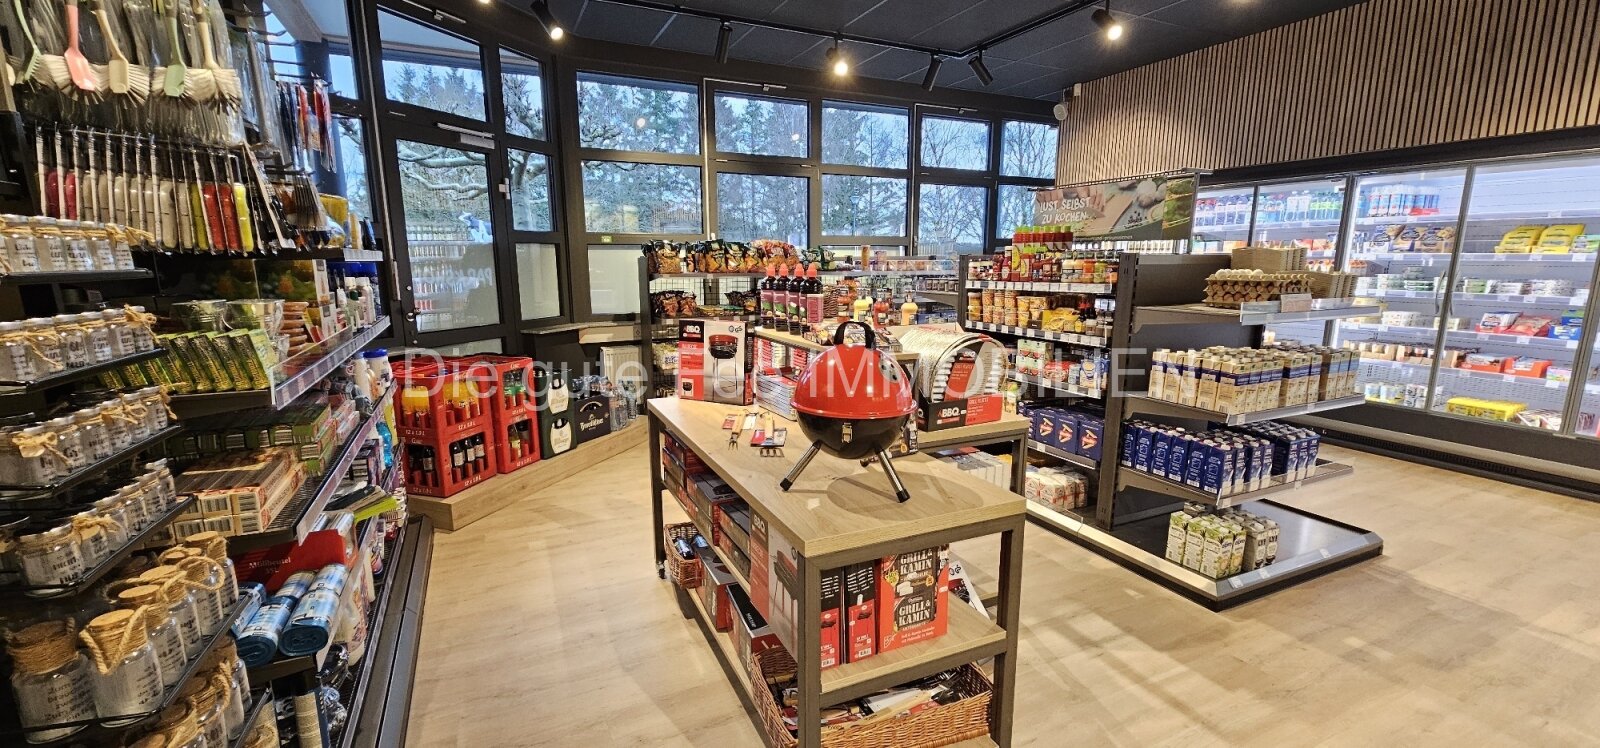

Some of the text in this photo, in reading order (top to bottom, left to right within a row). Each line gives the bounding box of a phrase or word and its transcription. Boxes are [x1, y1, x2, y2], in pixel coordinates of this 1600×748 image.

[1040, 197, 1091, 213] LUST, SELBST
[1042, 211, 1087, 224] ZU KOCHEN
[942, 406, 960, 418] BBQ
[901, 551, 927, 565] GRILL
[900, 558, 932, 575] KAMIN
[899, 602, 926, 616] GRILL
[926, 599, 931, 607] &
[898, 608, 930, 627] KAMIN
